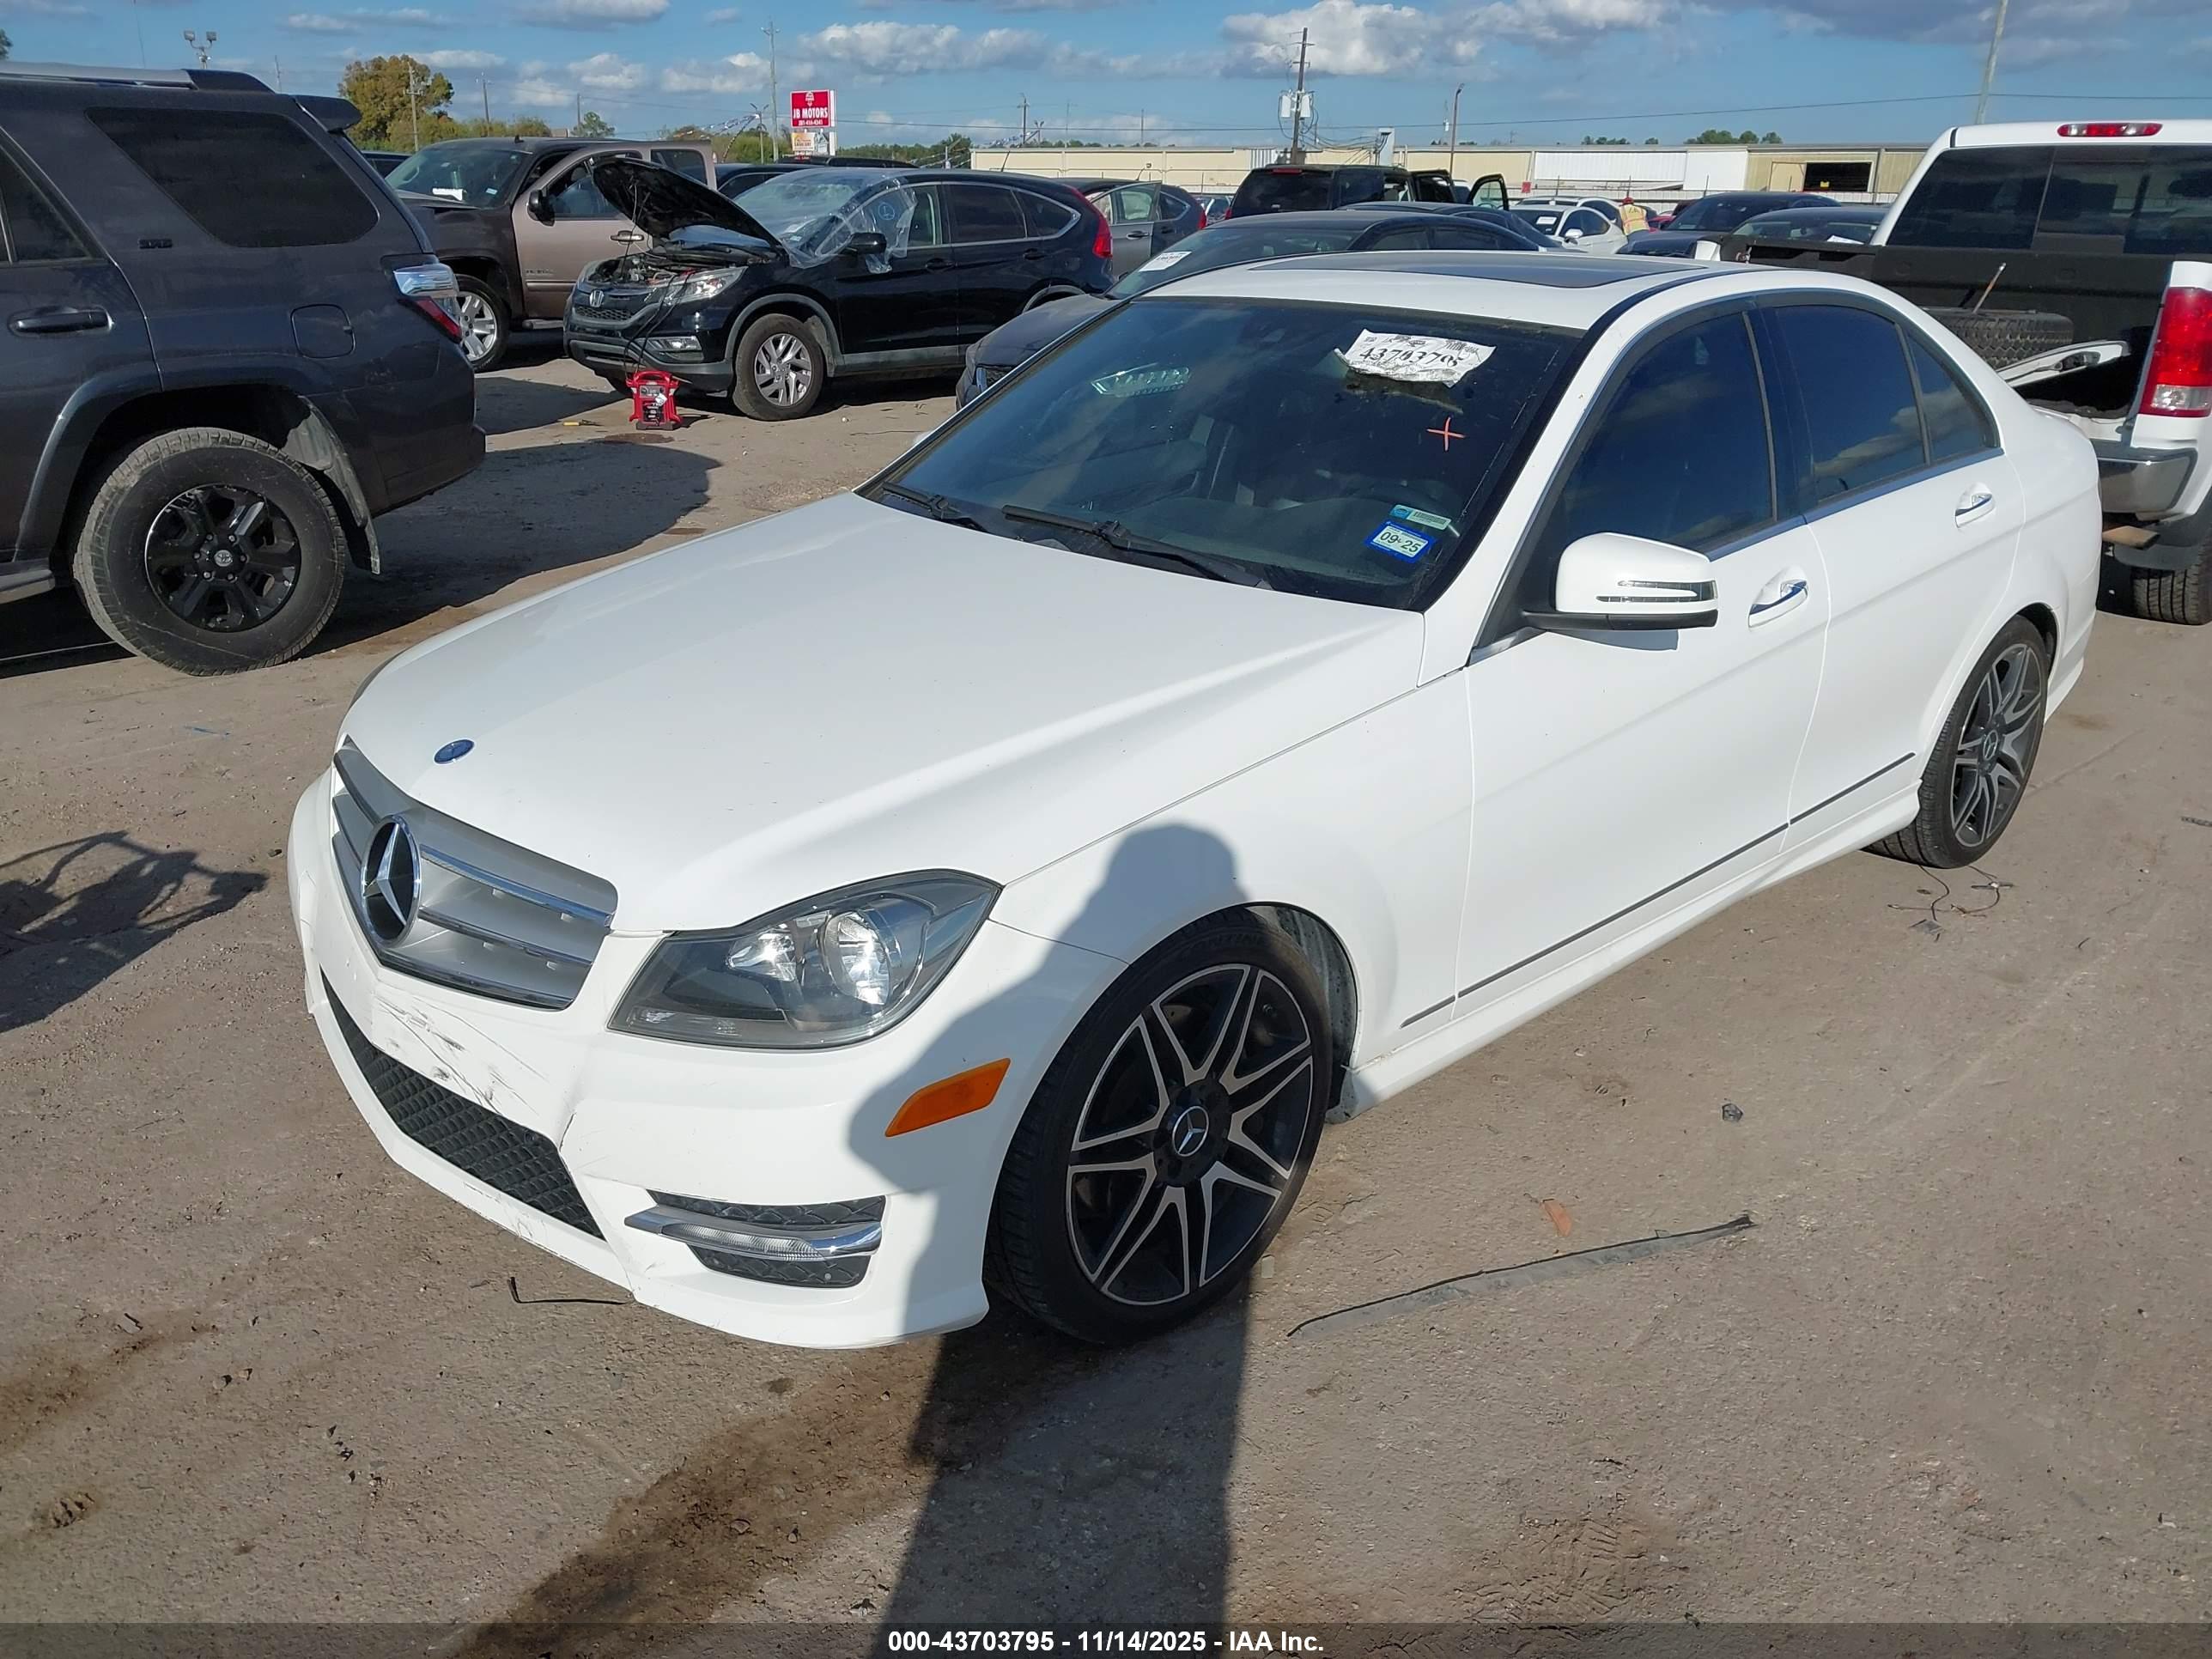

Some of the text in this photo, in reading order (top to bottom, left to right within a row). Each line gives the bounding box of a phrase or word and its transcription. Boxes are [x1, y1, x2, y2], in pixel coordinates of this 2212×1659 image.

[793, 107, 828, 118] JB MOTORS
[1380, 531, 1422, 553] 09 25
